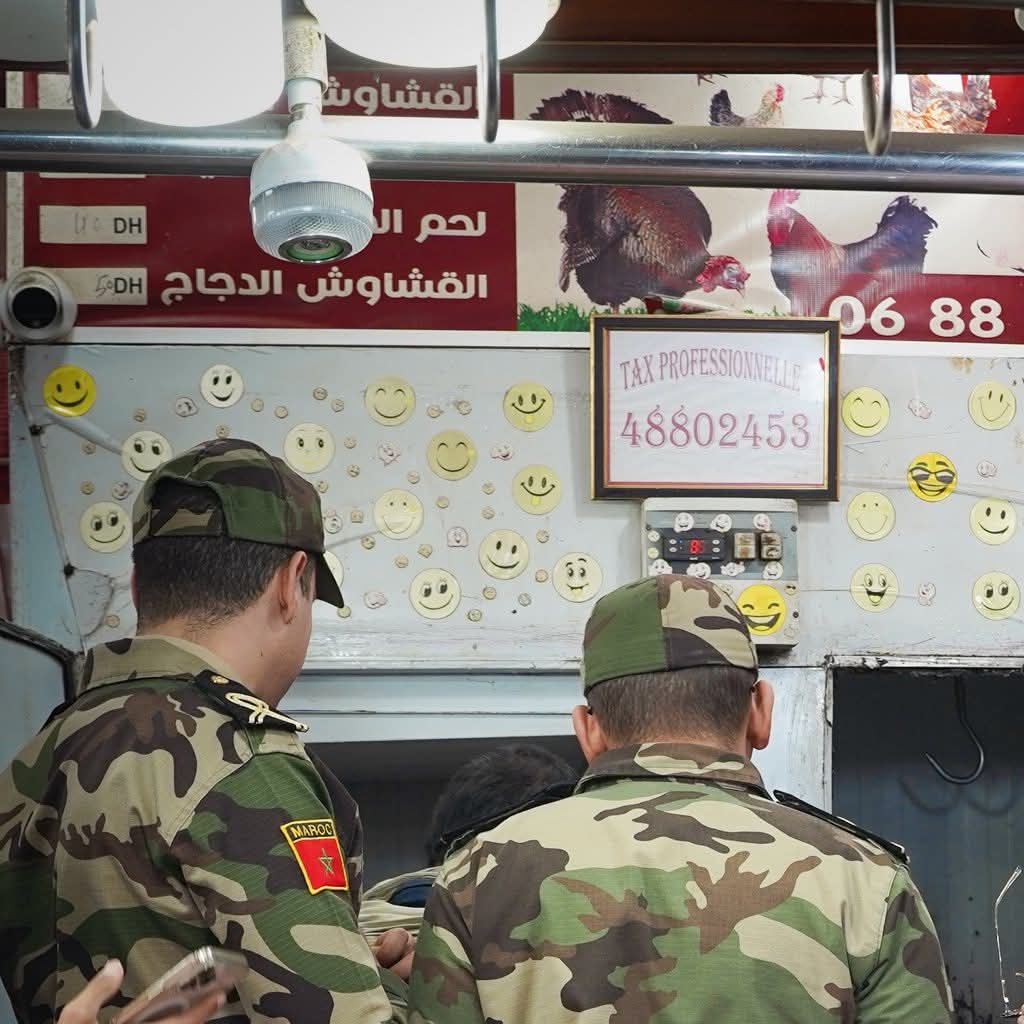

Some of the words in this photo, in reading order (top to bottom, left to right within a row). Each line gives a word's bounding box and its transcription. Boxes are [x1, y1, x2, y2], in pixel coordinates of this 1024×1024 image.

[322, 76, 478, 115] لقشاوش
[113, 217, 142, 234] DH
[415, 211, 487, 243] لحم
[114, 277, 142, 294] DH
[161, 268, 283, 306] الدجاج
[297, 266, 488, 306] القشاوش
[829, 295, 905, 336] 06
[929, 297, 1005, 339] 88
[620, 354, 655, 391] TAX
[659, 348, 801, 392] PROFESSIONNELLE
[620, 404, 810, 450] 48802453
[290, 824, 333, 838] MAROC
